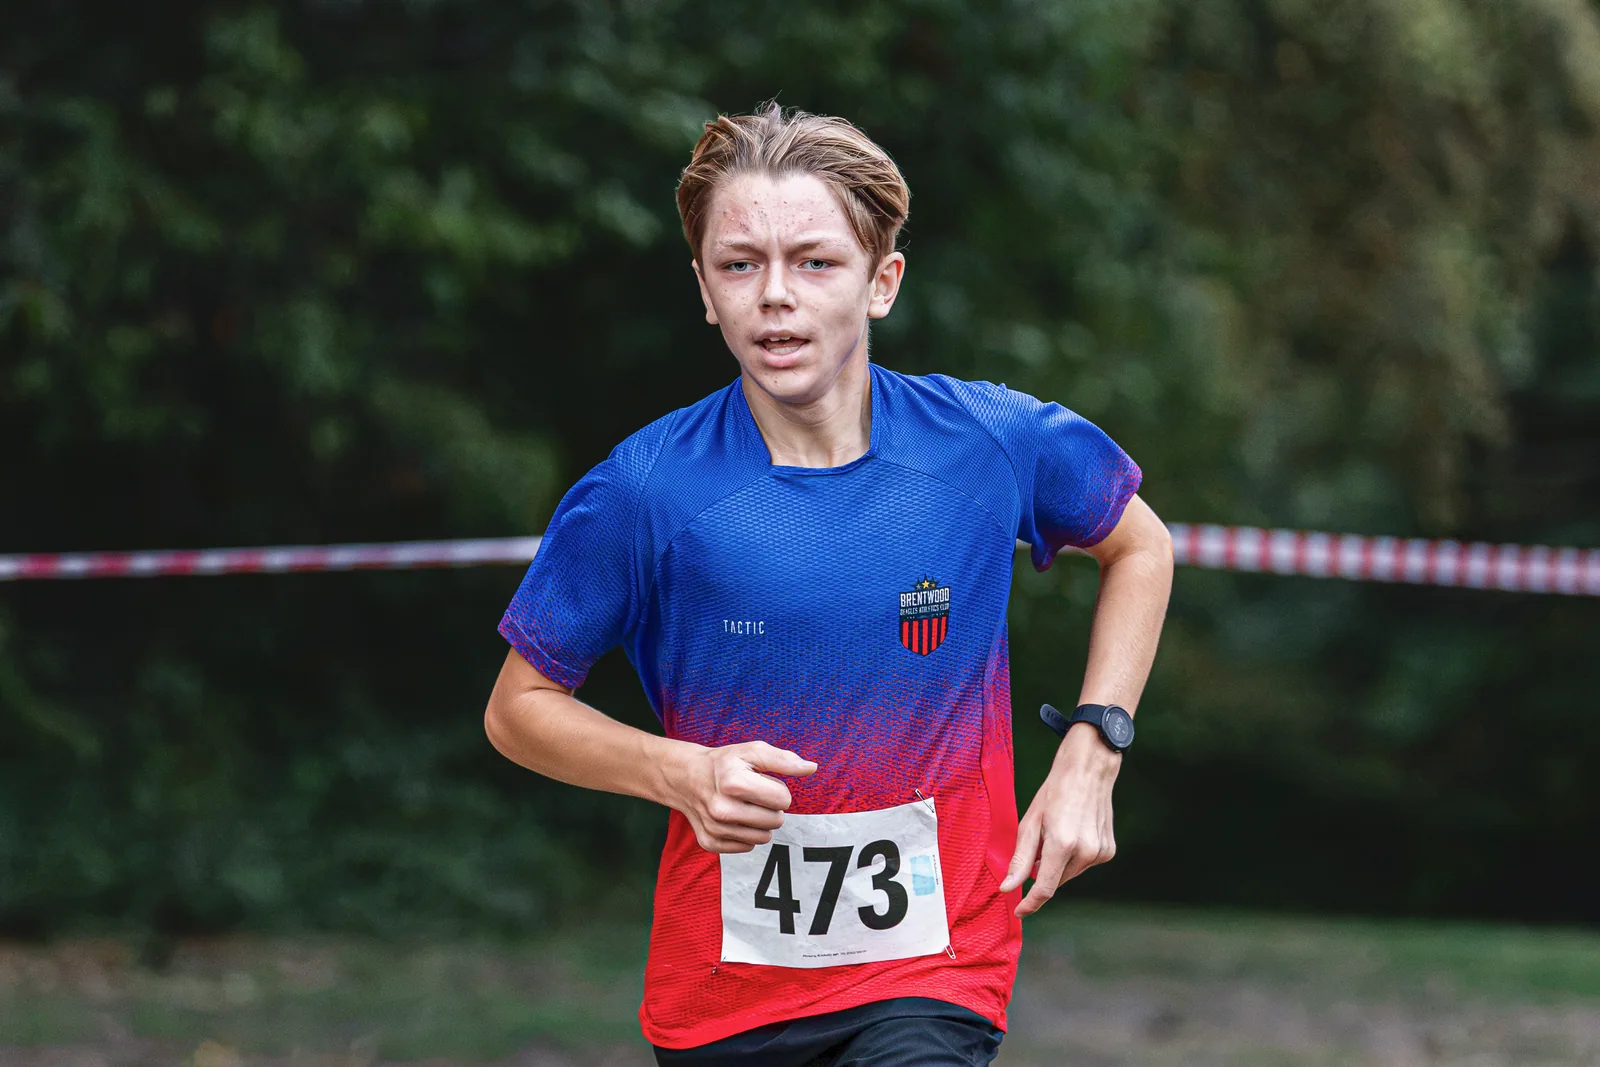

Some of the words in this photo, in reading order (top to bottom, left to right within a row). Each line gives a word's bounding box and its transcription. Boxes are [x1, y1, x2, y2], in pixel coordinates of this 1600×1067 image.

[900, 588, 949, 607] BRENTWOOD
[919, 605, 939, 613] ATHLETICS
[723, 619, 765, 635] TACTIC
[754, 839, 909, 936] 473
